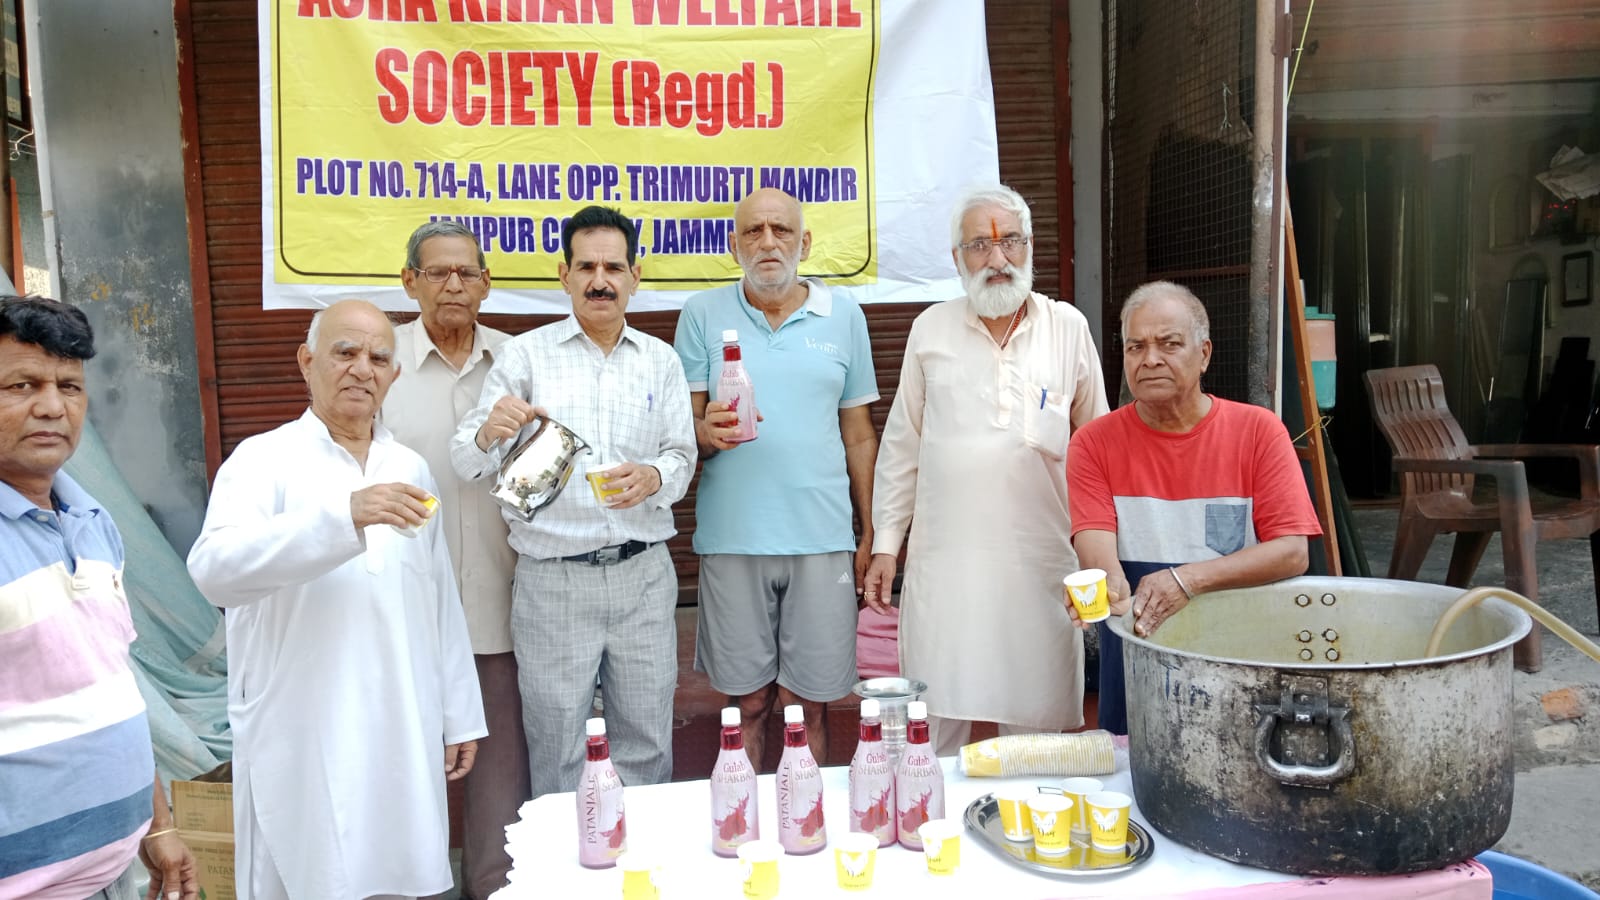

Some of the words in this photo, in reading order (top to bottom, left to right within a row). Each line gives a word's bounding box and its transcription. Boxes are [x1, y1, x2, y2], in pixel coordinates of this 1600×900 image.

[375, 48, 599, 127] SOCIETY
[611, 61, 784, 136] (Regd.)
[296, 157, 363, 196] PLOT
[369, 161, 411, 198] NO.
[414, 161, 492, 203] 714-A,
[497, 163, 561, 200] LANE
[567, 163, 622, 201] OPP.
[626, 164, 754, 202] TRIMURTI
[760, 166, 858, 203] MANDIR
[723, 760, 746, 773] Gulab
[907, 754, 930, 766] Gulab
